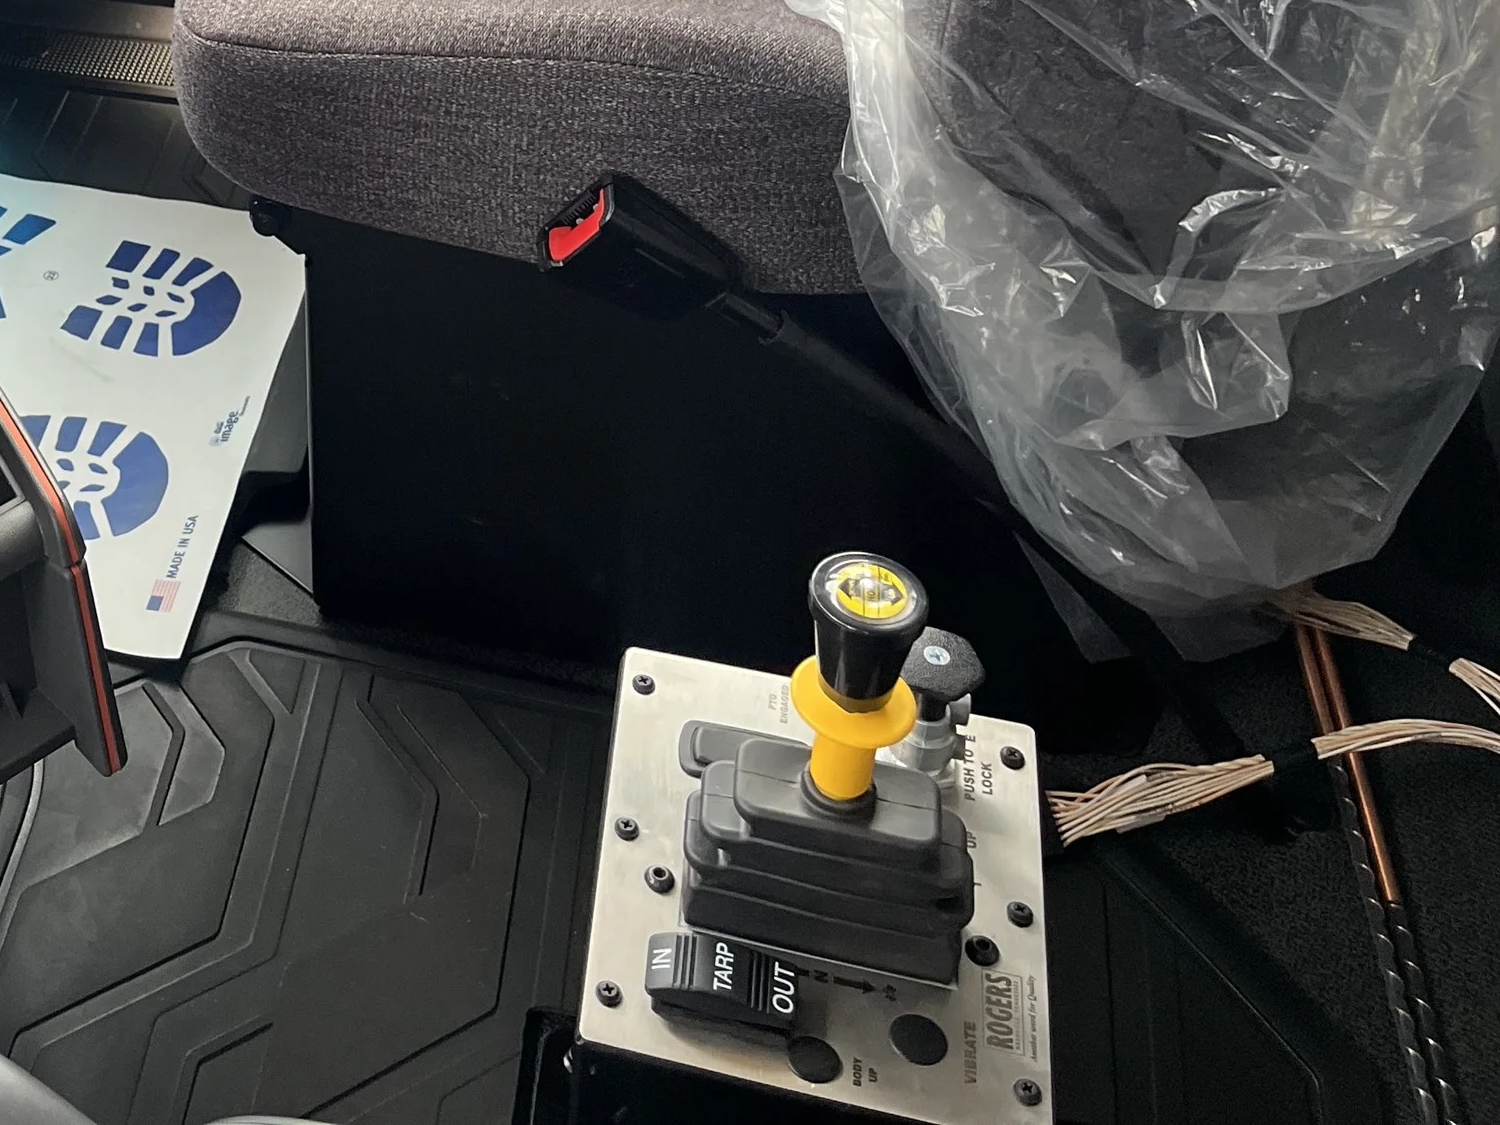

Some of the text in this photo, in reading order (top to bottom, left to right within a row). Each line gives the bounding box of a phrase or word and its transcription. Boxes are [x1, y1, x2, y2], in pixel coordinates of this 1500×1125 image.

[219, 411, 240, 443] image
[166, 515, 199, 579] MADE IN USA
[768, 693, 776, 711] PTO
[779, 684, 789, 724] ENGAGED
[964, 747, 976, 765] TO
[964, 768, 976, 801] PUSH
[981, 761, 993, 796] LOCK
[651, 948, 672, 969] IN
[712, 942, 735, 990] TARP
[772, 961, 795, 1014] OUT
[984, 973, 1014, 1050] ROGERS
[1027, 975, 1038, 1063] Another word for Quality
[963, 1021, 977, 1084] VIBRATE
[852, 1057, 862, 1087] BODY
[868, 1067, 878, 1083] UP
